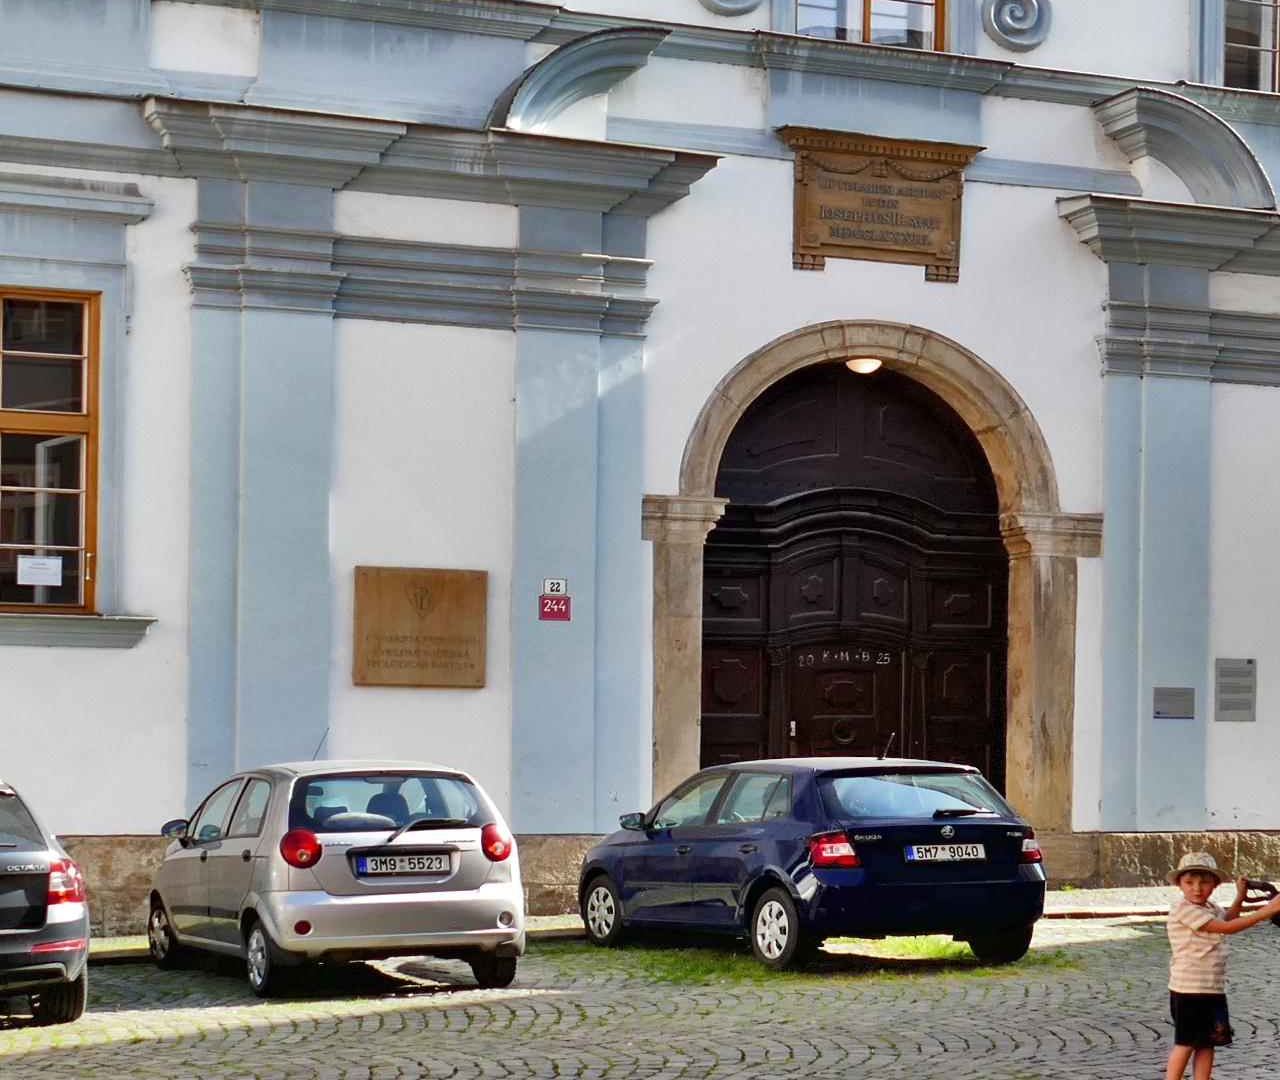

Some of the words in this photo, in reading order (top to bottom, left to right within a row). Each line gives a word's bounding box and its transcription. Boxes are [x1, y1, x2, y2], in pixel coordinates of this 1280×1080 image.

[821, 205, 892, 226] IOSEPHUS
[549, 581, 561, 593] 22
[543, 599, 566, 612] 244
[798, 654, 815, 667] 20
[876, 652, 891, 665] 25
[917, 847, 939, 859] 5M7
[950, 846, 979, 858] 9040
[371, 858, 396, 871] 3M9
[408, 857, 443, 870] 5523
